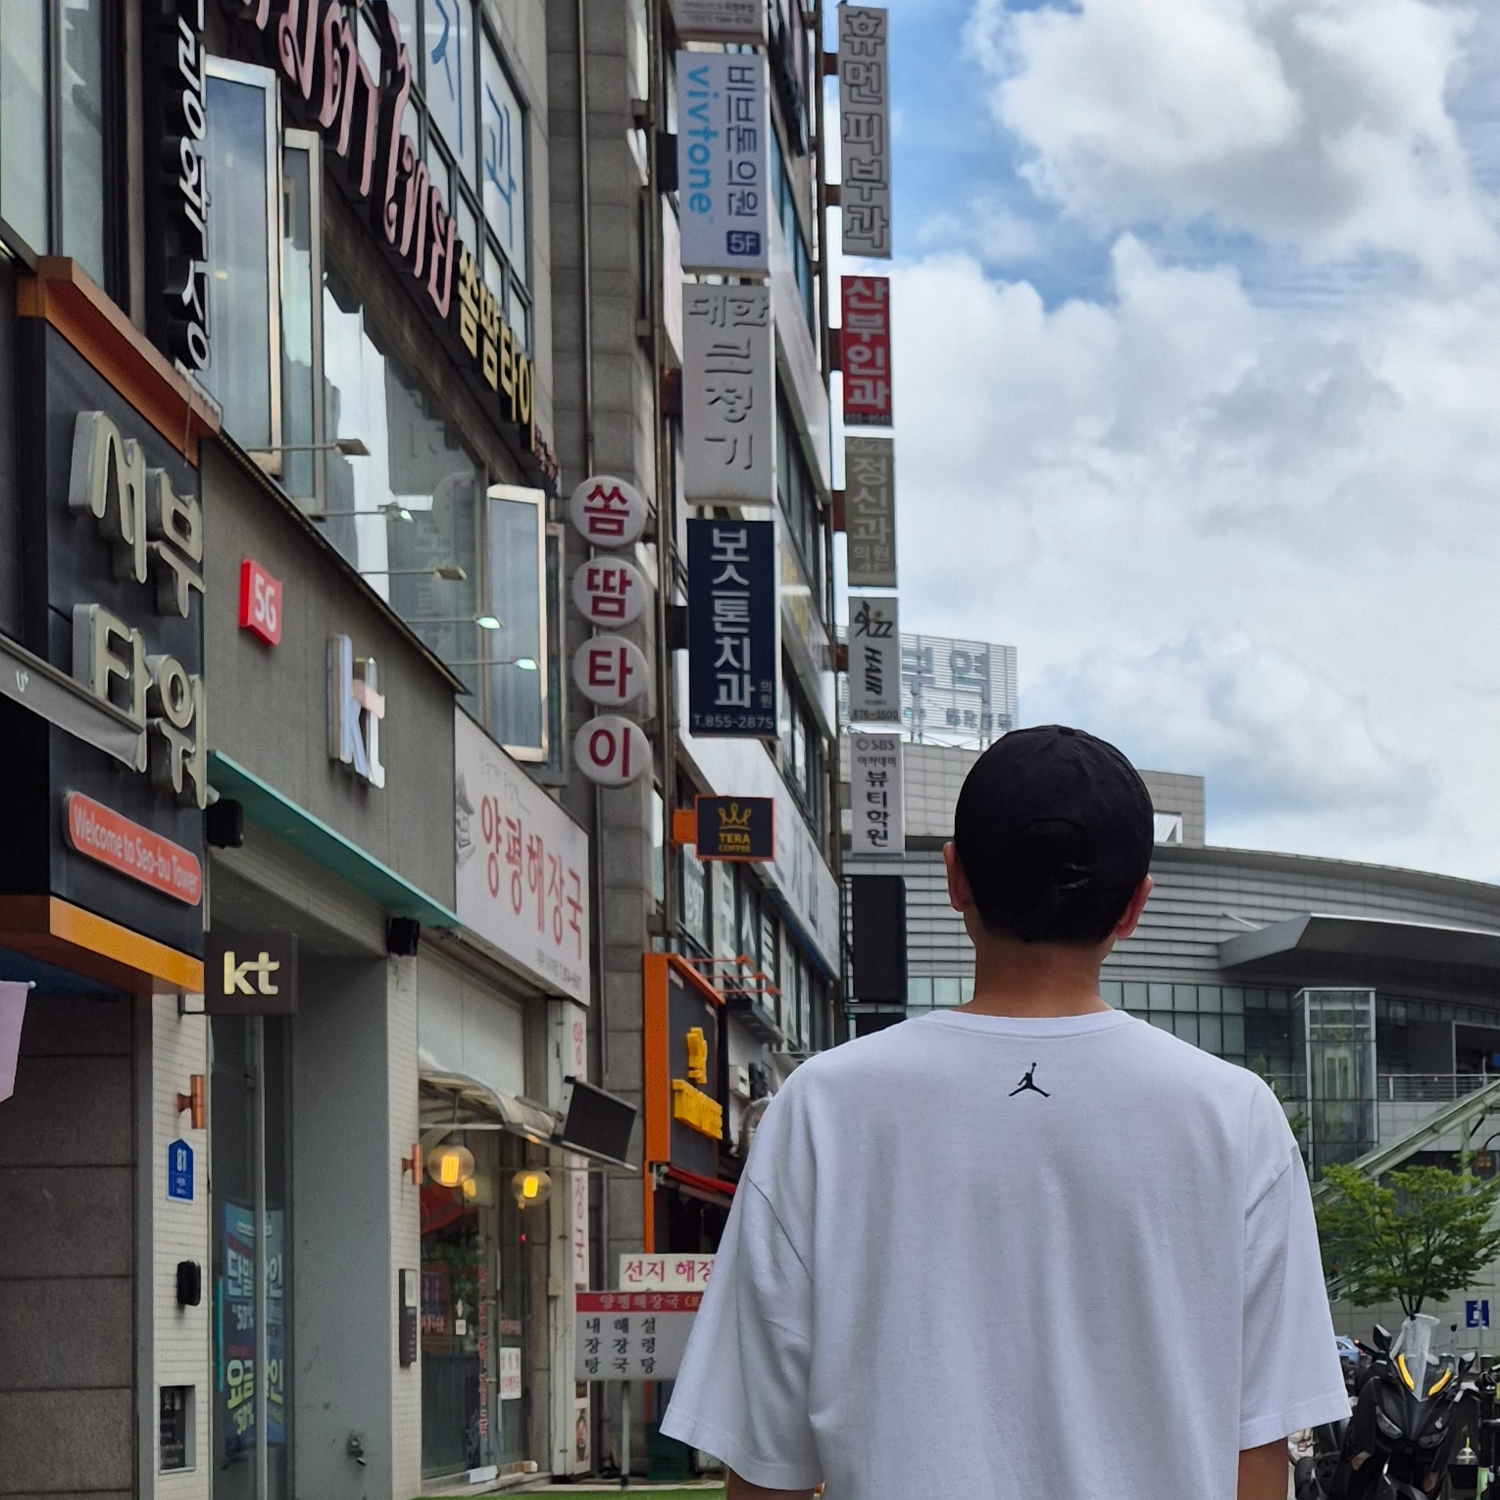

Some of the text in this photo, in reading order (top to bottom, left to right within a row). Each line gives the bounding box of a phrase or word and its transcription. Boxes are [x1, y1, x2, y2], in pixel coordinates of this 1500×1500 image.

[686, 66, 720, 215] vivtone
[726, 66, 758, 217] 비브톤의원
[846, 279, 890, 410] 산부인과
[79, 412, 205, 618] 서부
[850, 457, 891, 545] 정신과
[254, 573, 276, 634] 5G
[584, 485, 634, 778] 쏨땀타이
[710, 527, 756, 708] 보스톤치과
[760, 681, 773, 708] 의원
[865, 646, 882, 696] HAIR
[88, 604, 206, 810] 타워
[340, 635, 386, 790] kt
[693, 714, 774, 730] T.855-2875
[858, 756, 896, 768] 아카데미
[871, 739, 895, 751] SBS
[74, 804, 122, 859] Welcome
[123, 834, 135, 865] to
[719, 832, 750, 845] TERA
[865, 770, 890, 848] 뷰티학원
[480, 795, 582, 961] 양평해장국
[223, 951, 280, 996] kt
[176, 1148, 187, 1173] 81
[600, 1294, 681, 1310] 양평해장국
[624, 1260, 665, 1283] 선지
[584, 1317, 602, 1374] 내장탕
[612, 1317, 630, 1374] 해장국
